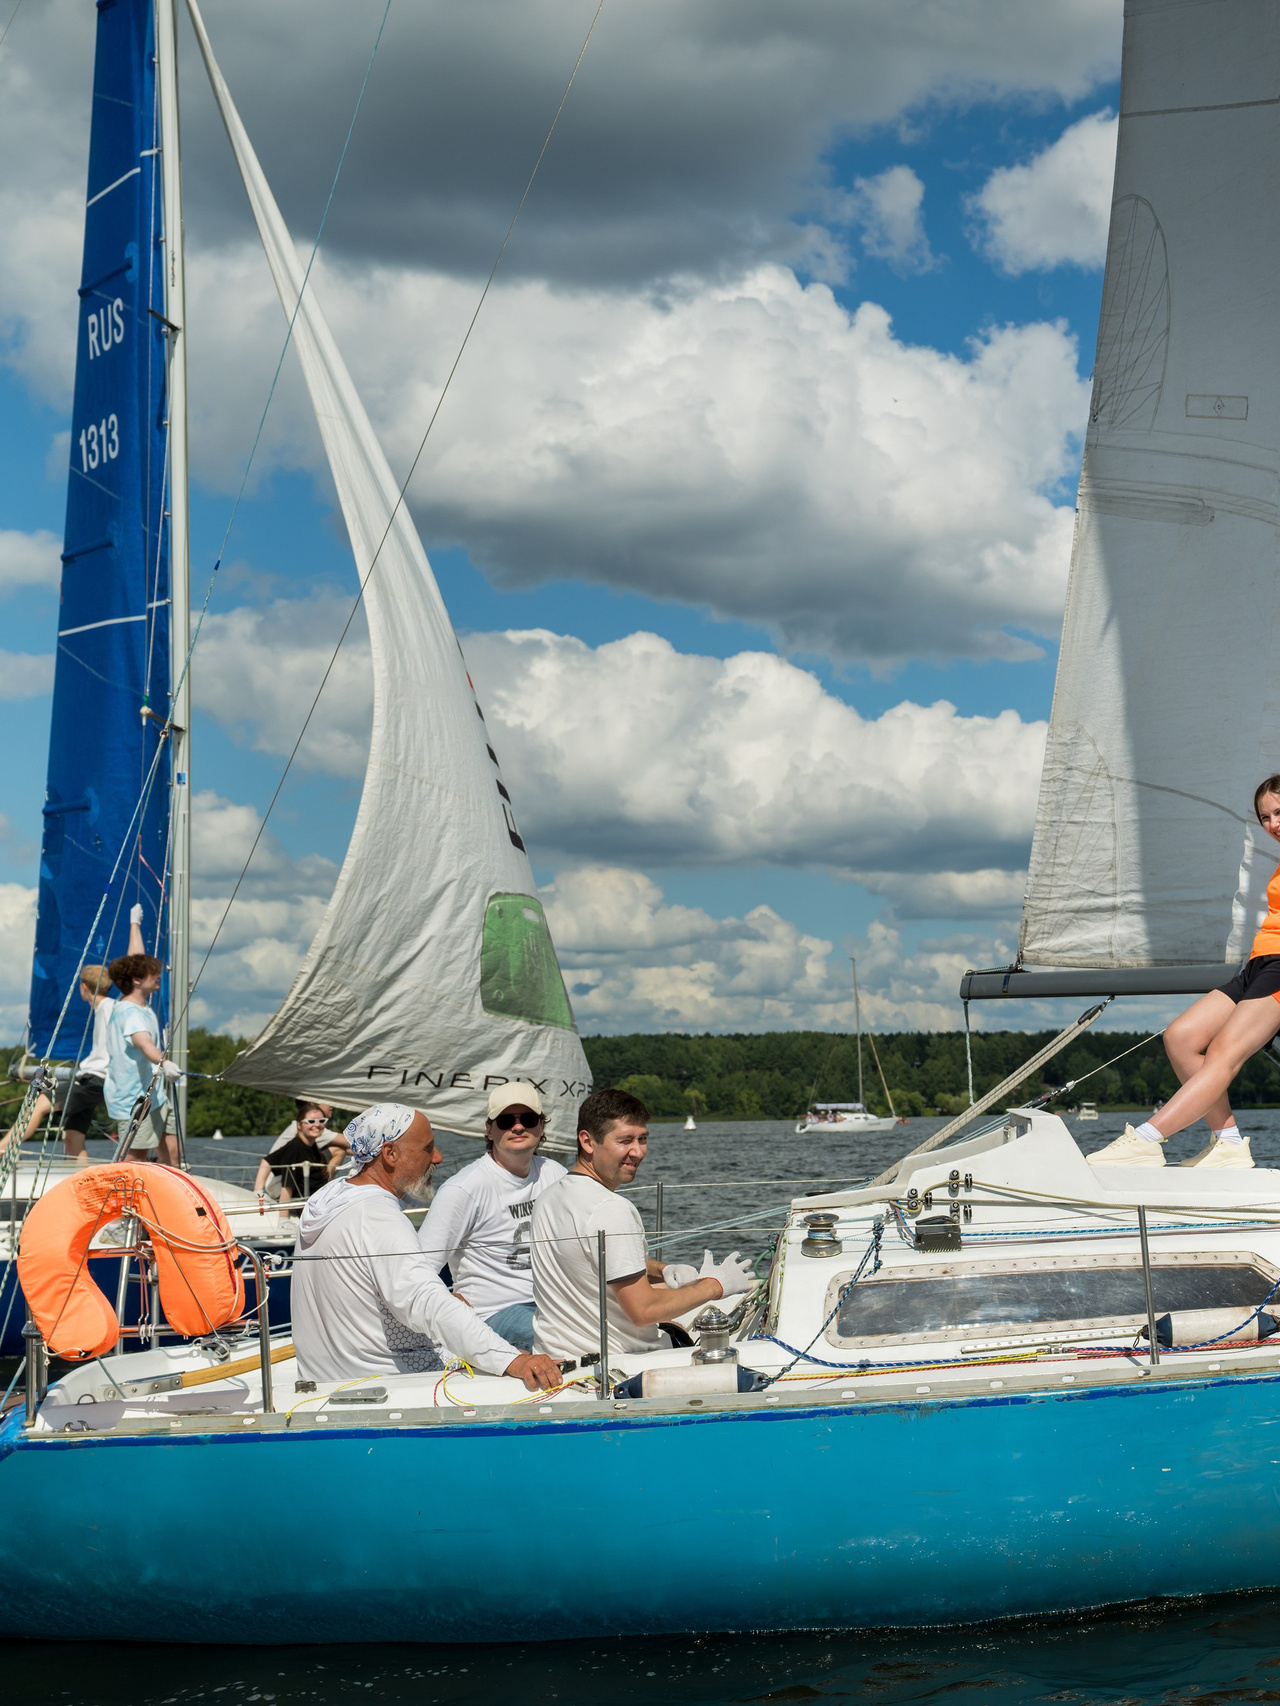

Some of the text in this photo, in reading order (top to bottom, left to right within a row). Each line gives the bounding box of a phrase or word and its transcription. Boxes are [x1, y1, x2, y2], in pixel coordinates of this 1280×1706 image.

[88, 297, 124, 360] RUS
[79, 413, 120, 473] 1313
[367, 1065, 548, 1096] FINEPX
[508, 1199, 536, 1220] WINN
